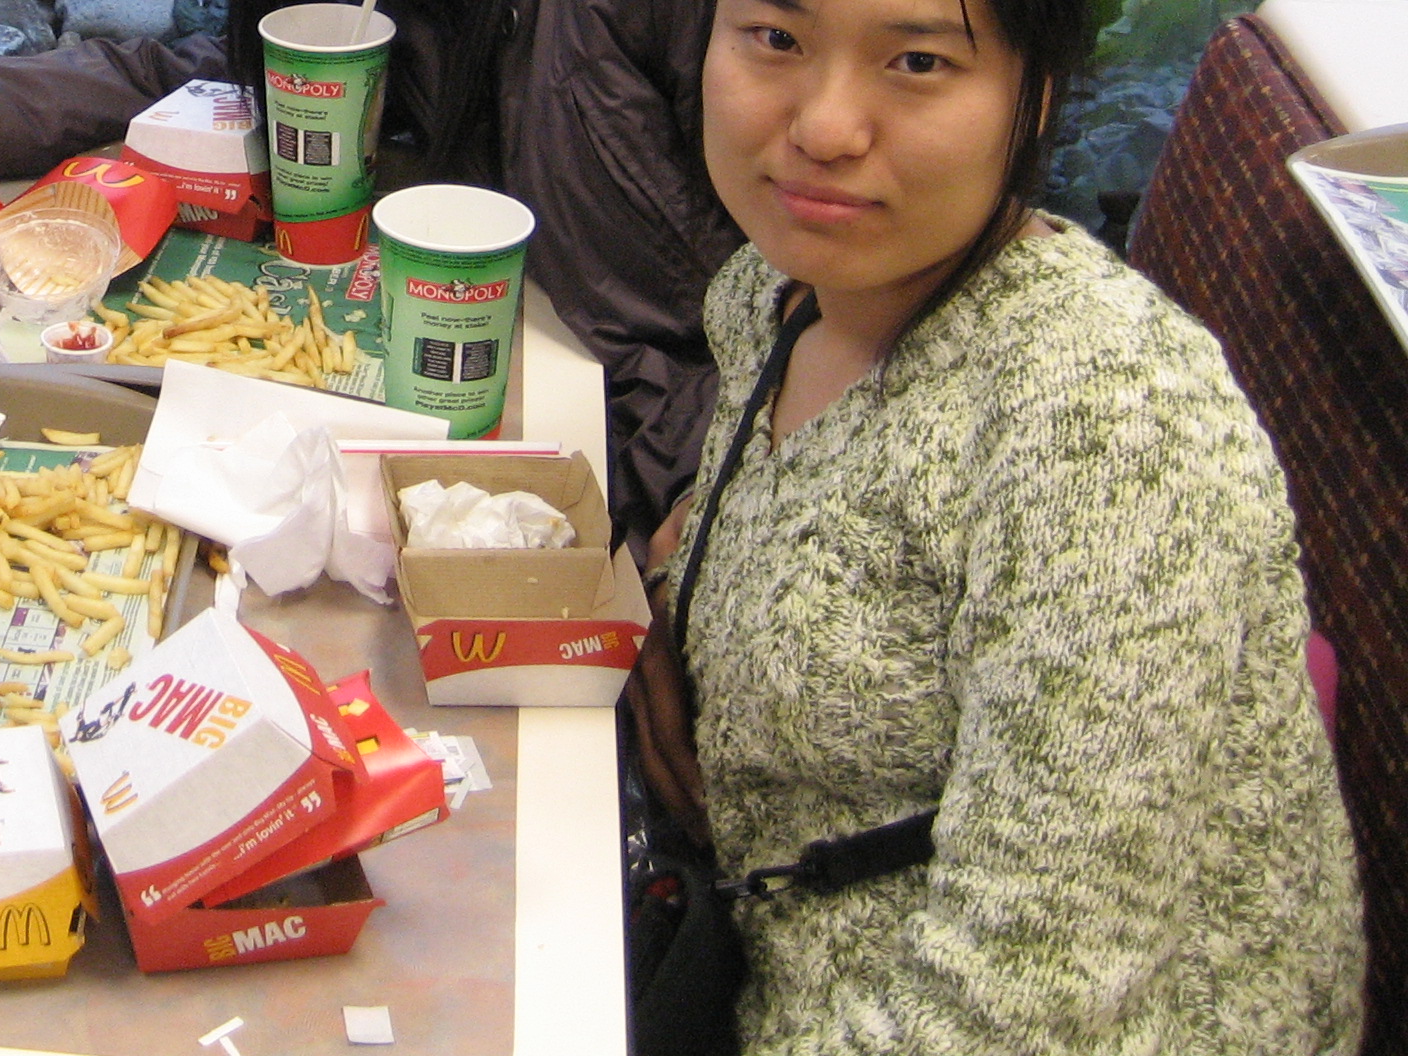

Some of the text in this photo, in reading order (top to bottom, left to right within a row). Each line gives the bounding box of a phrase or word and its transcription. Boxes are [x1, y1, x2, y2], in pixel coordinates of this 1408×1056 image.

[268, 73, 339, 96] MONOPOLY
[409, 280, 505, 301] MONOPOLY
[559, 636, 603, 659] MAC
[129, 674, 252, 749] BIG MAC
[257, 817, 285, 841] lovin'
[233, 916, 307, 954] MAC
